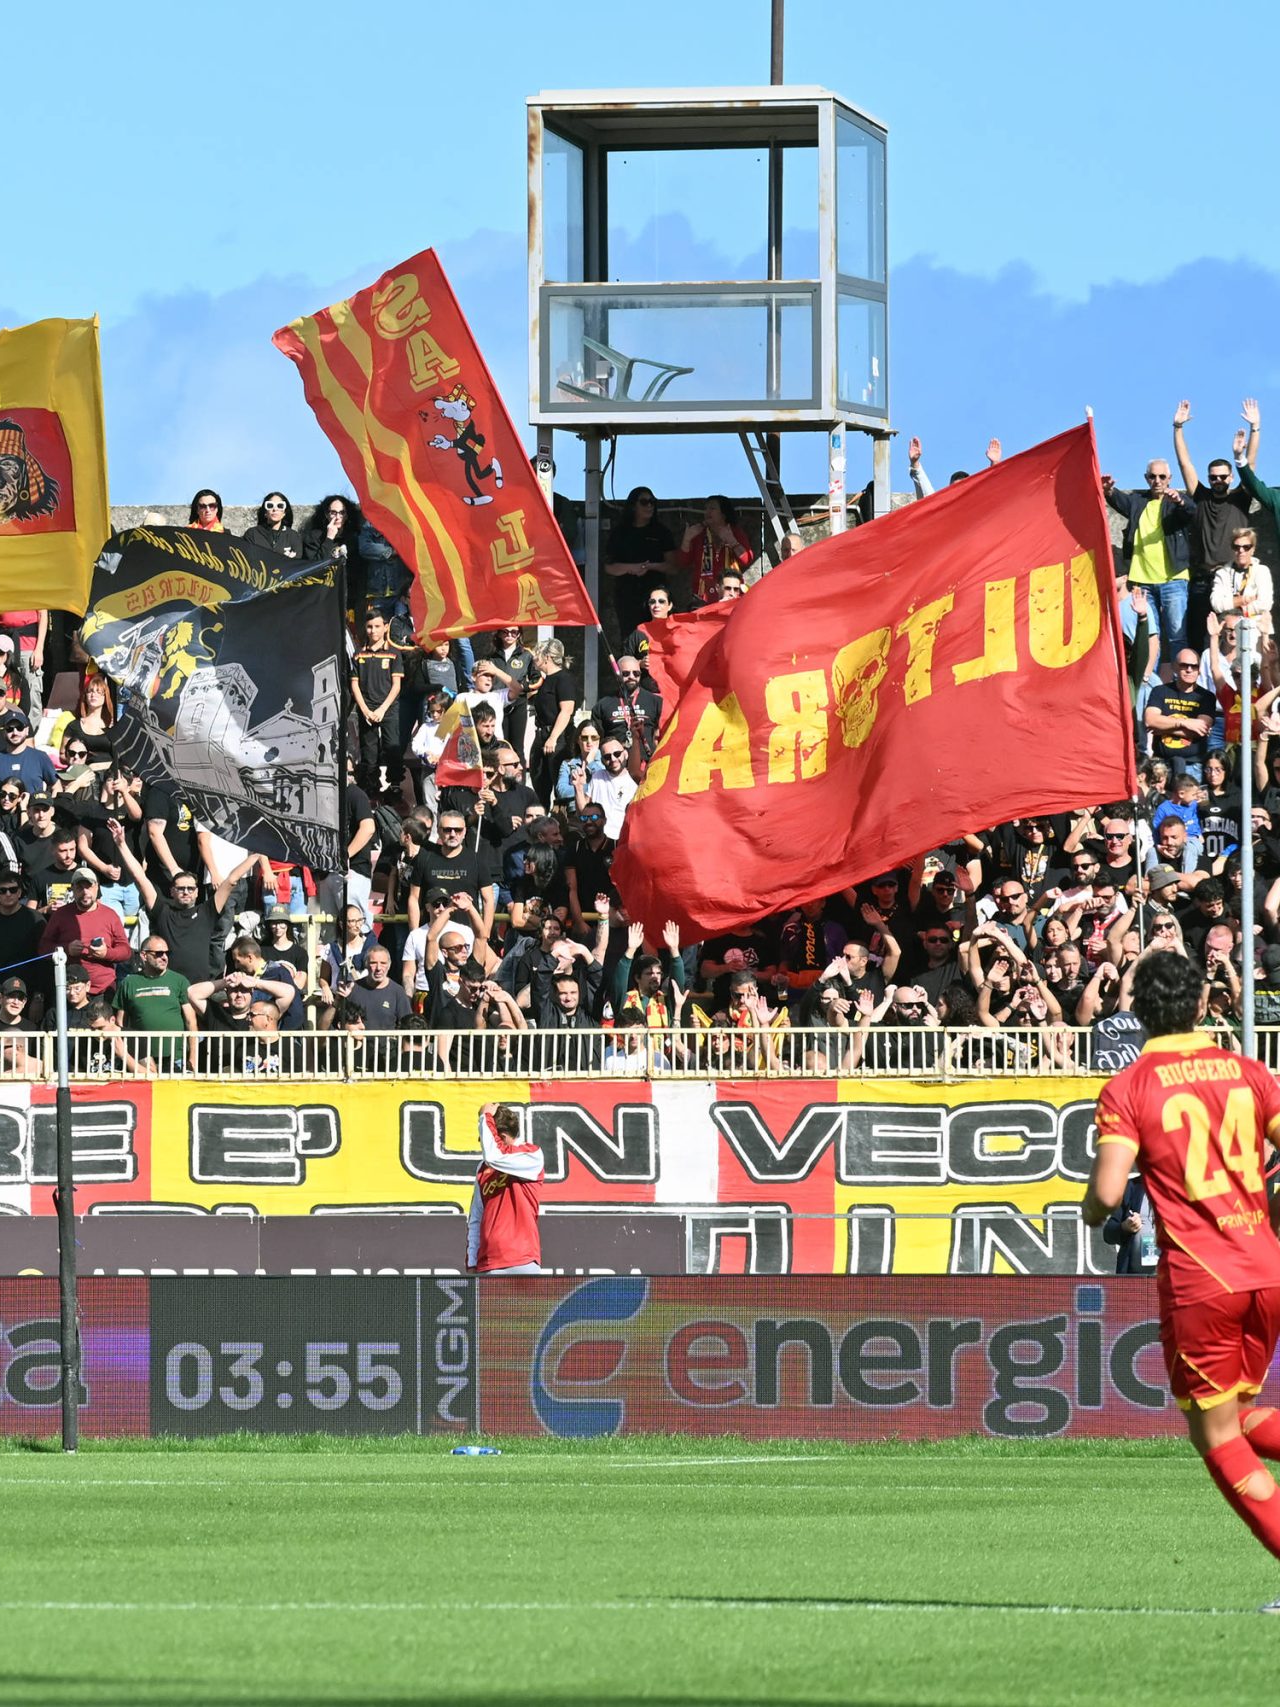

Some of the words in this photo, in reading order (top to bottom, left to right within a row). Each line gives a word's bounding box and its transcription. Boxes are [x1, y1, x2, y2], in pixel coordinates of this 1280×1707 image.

[1154, 1058, 1242, 1088] RUGGERO
[398, 1100, 661, 1186] UN
[1161, 1087, 1264, 1202] 24
[166, 1342, 403, 1410] 03:55
[435, 1279, 470, 1422] NGM
[665, 1285, 1168, 1437] energic
